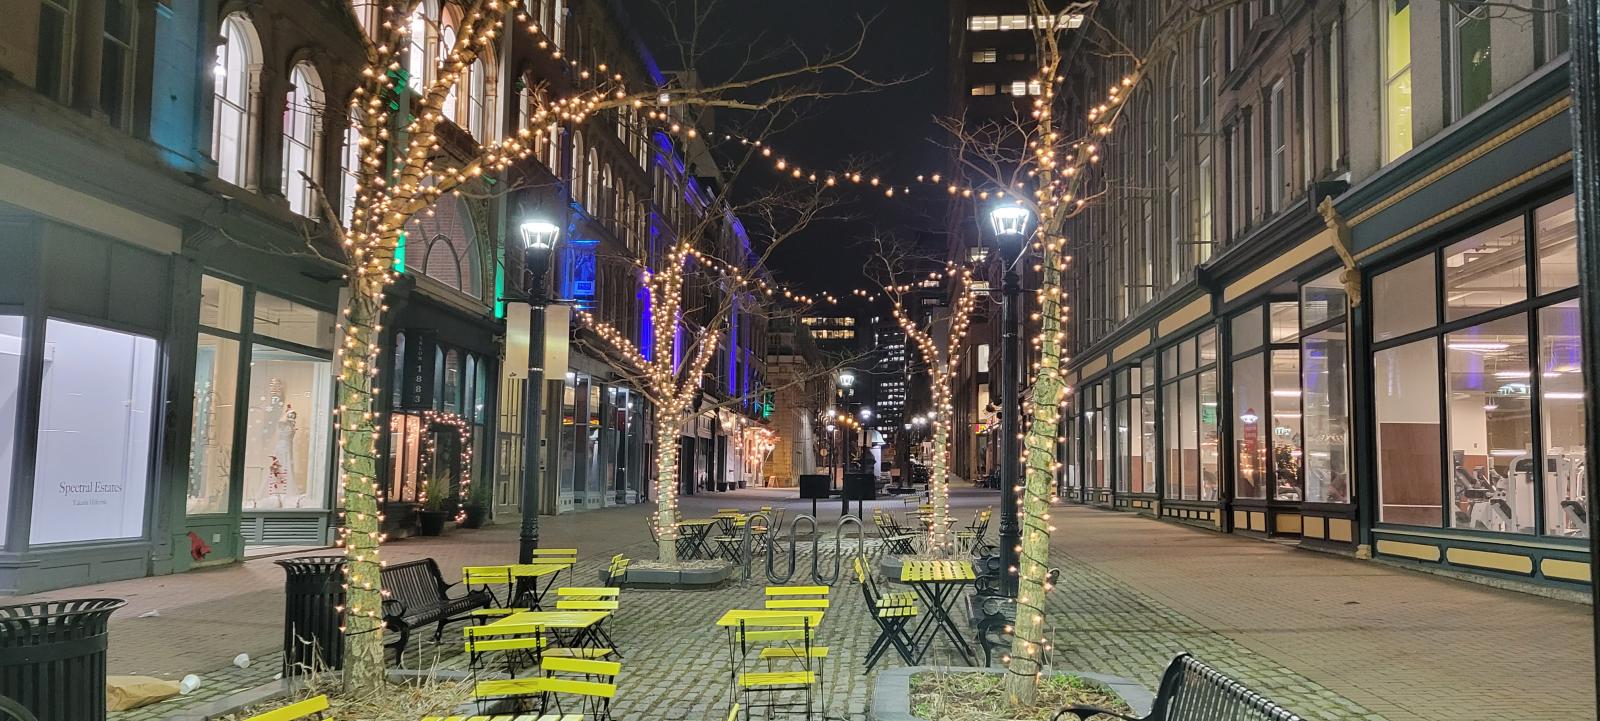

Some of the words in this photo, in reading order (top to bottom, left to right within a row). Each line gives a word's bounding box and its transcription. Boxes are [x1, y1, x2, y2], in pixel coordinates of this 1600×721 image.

[414, 364, 423, 403] 1883
[58, 481, 93, 496] Spectral
[94, 481, 122, 493] Estates
